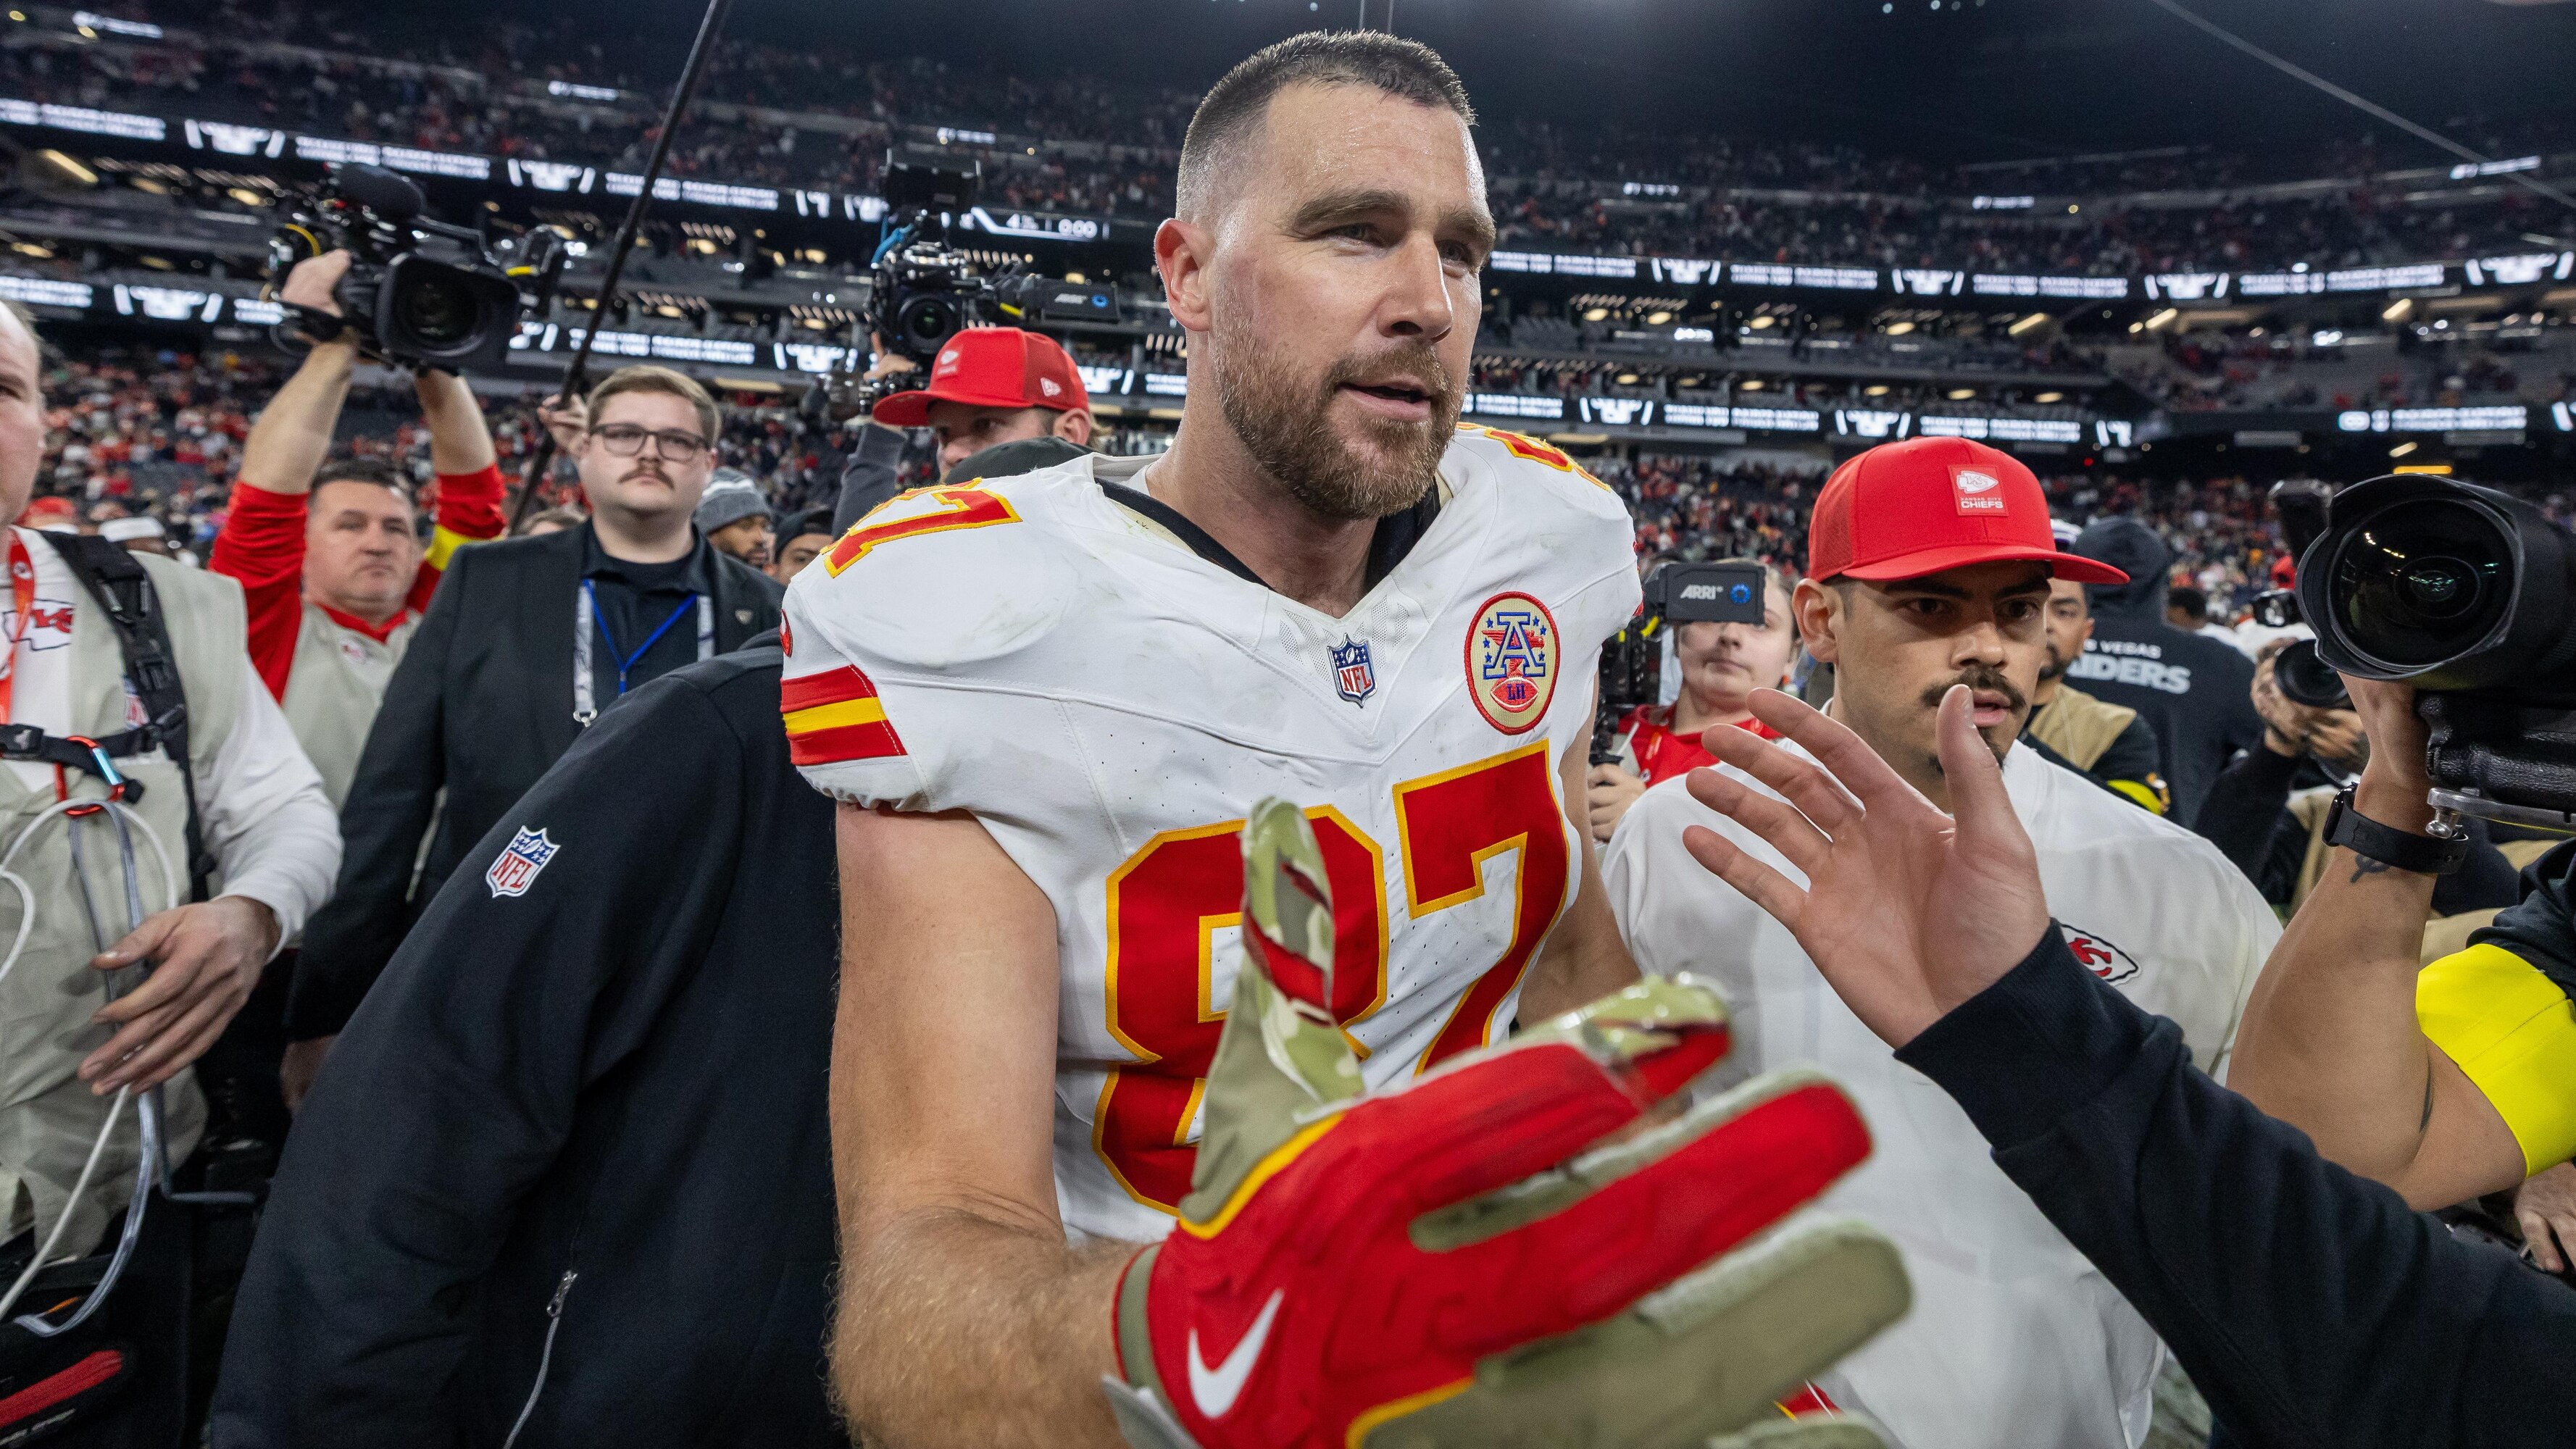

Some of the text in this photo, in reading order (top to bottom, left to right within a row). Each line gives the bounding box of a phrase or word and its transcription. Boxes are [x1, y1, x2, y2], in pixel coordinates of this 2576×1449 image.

[1680, 584, 1717, 600] ARRI
[1483, 612, 1546, 680] A
[2099, 640, 2162, 659] VEGAS
[1340, 665, 1372, 694] NFL
[2067, 652, 2191, 695] IDERS
[1506, 684, 1525, 700] LH
[492, 852, 533, 889] NFL
[1092, 739, 1570, 1217] 87
